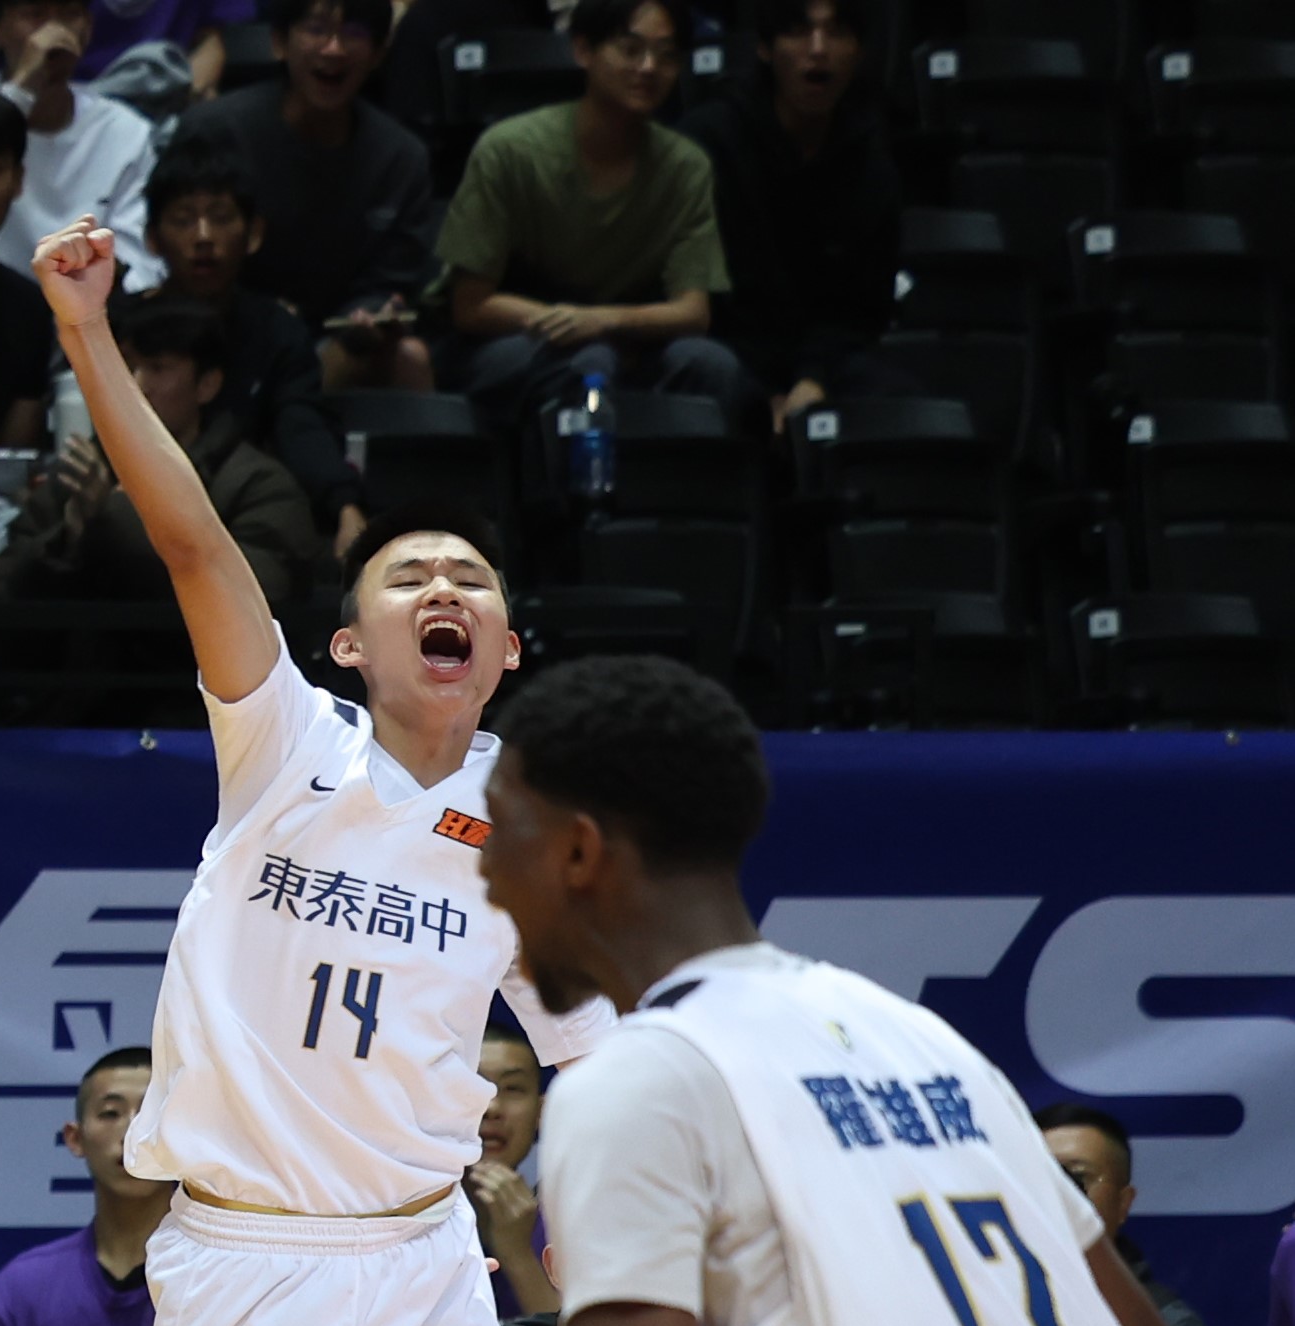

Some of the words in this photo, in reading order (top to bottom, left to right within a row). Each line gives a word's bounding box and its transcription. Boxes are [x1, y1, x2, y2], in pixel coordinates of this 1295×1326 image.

[248, 853, 467, 953] 東泰高中
[301, 961, 384, 1061] 14
